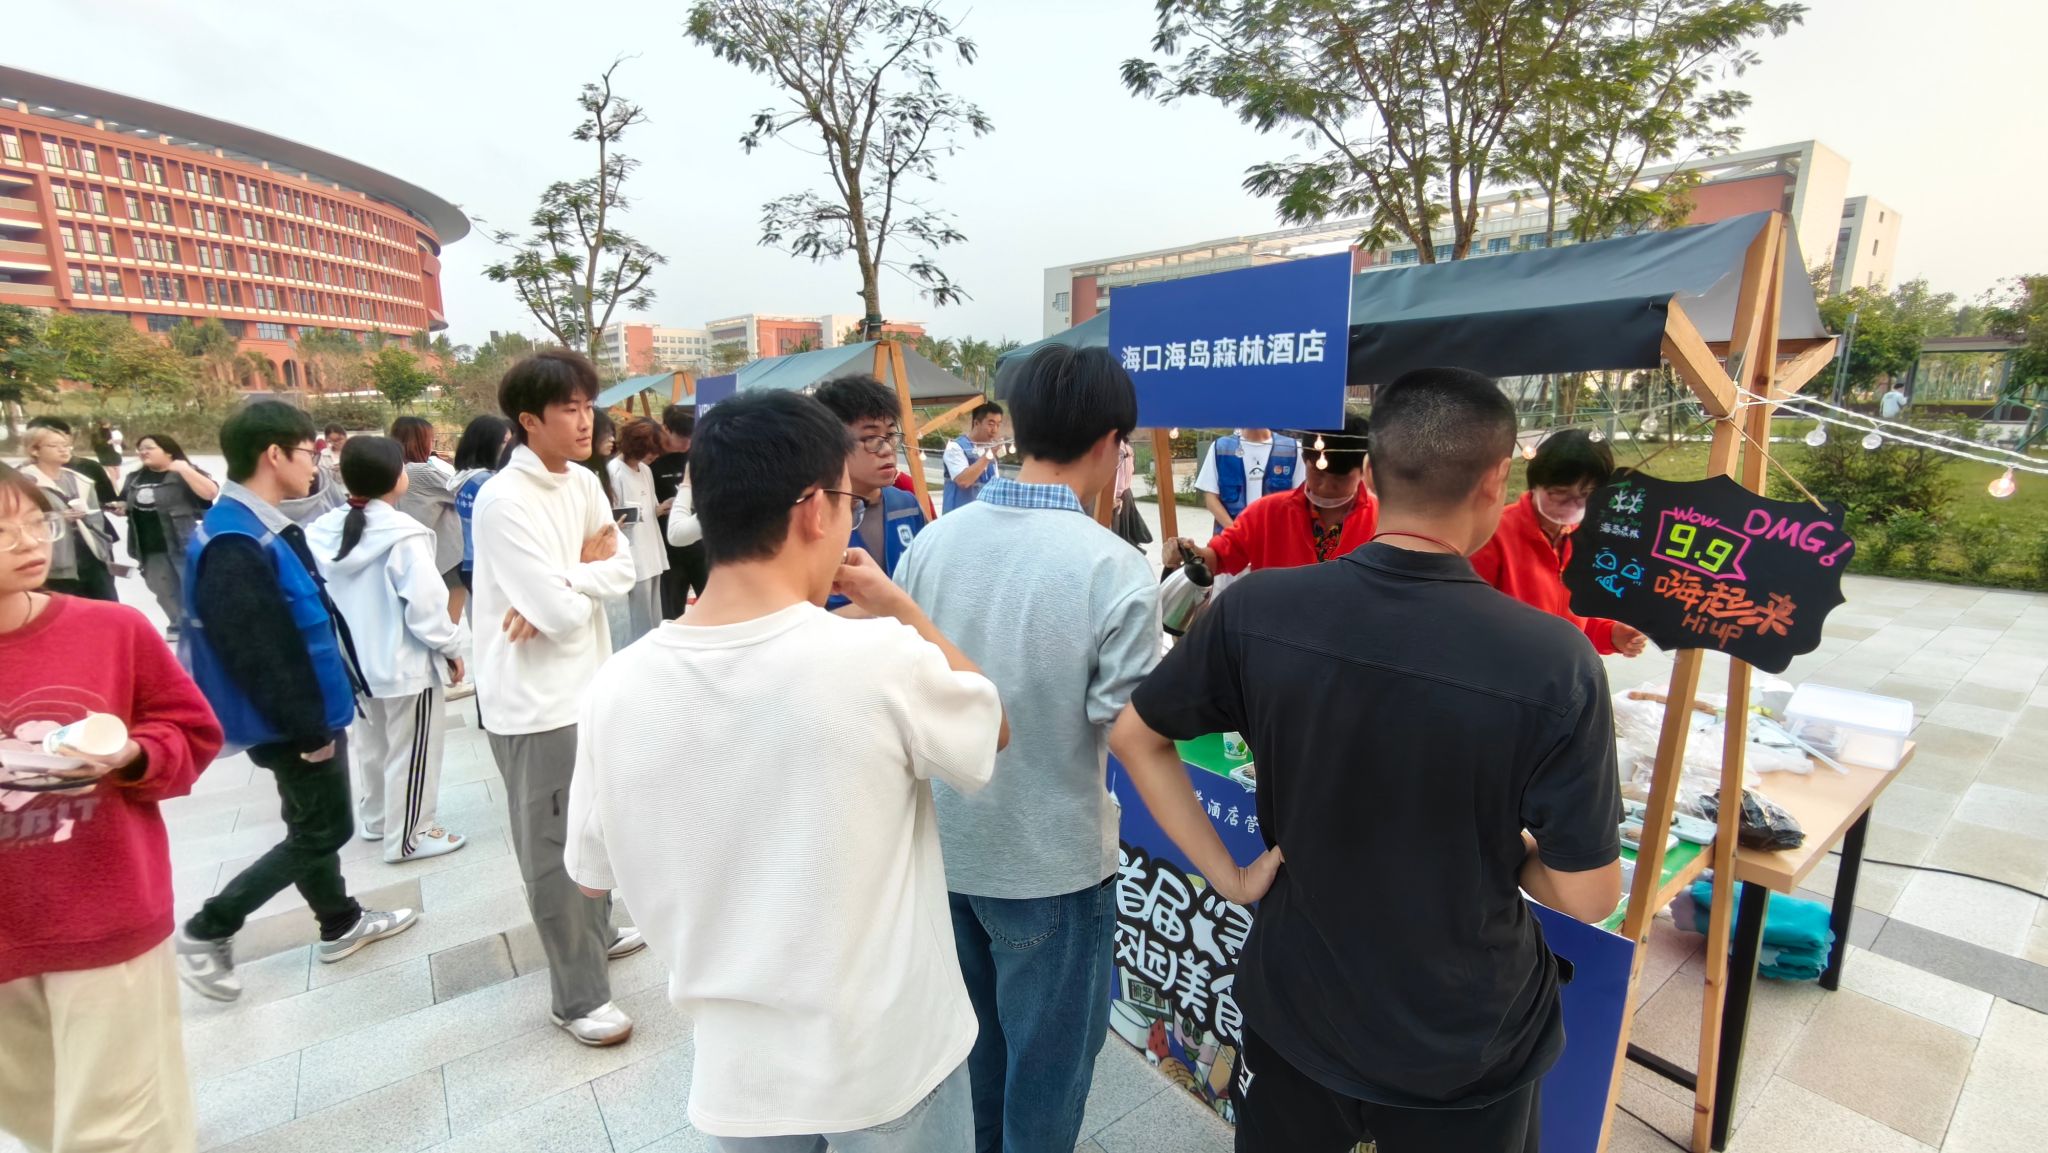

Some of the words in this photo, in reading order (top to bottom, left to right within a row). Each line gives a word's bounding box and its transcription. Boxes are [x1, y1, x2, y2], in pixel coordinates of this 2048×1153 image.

[1121, 329, 1327, 372] 海口海岛森林酒店
[1665, 523, 1734, 573] 9.9
